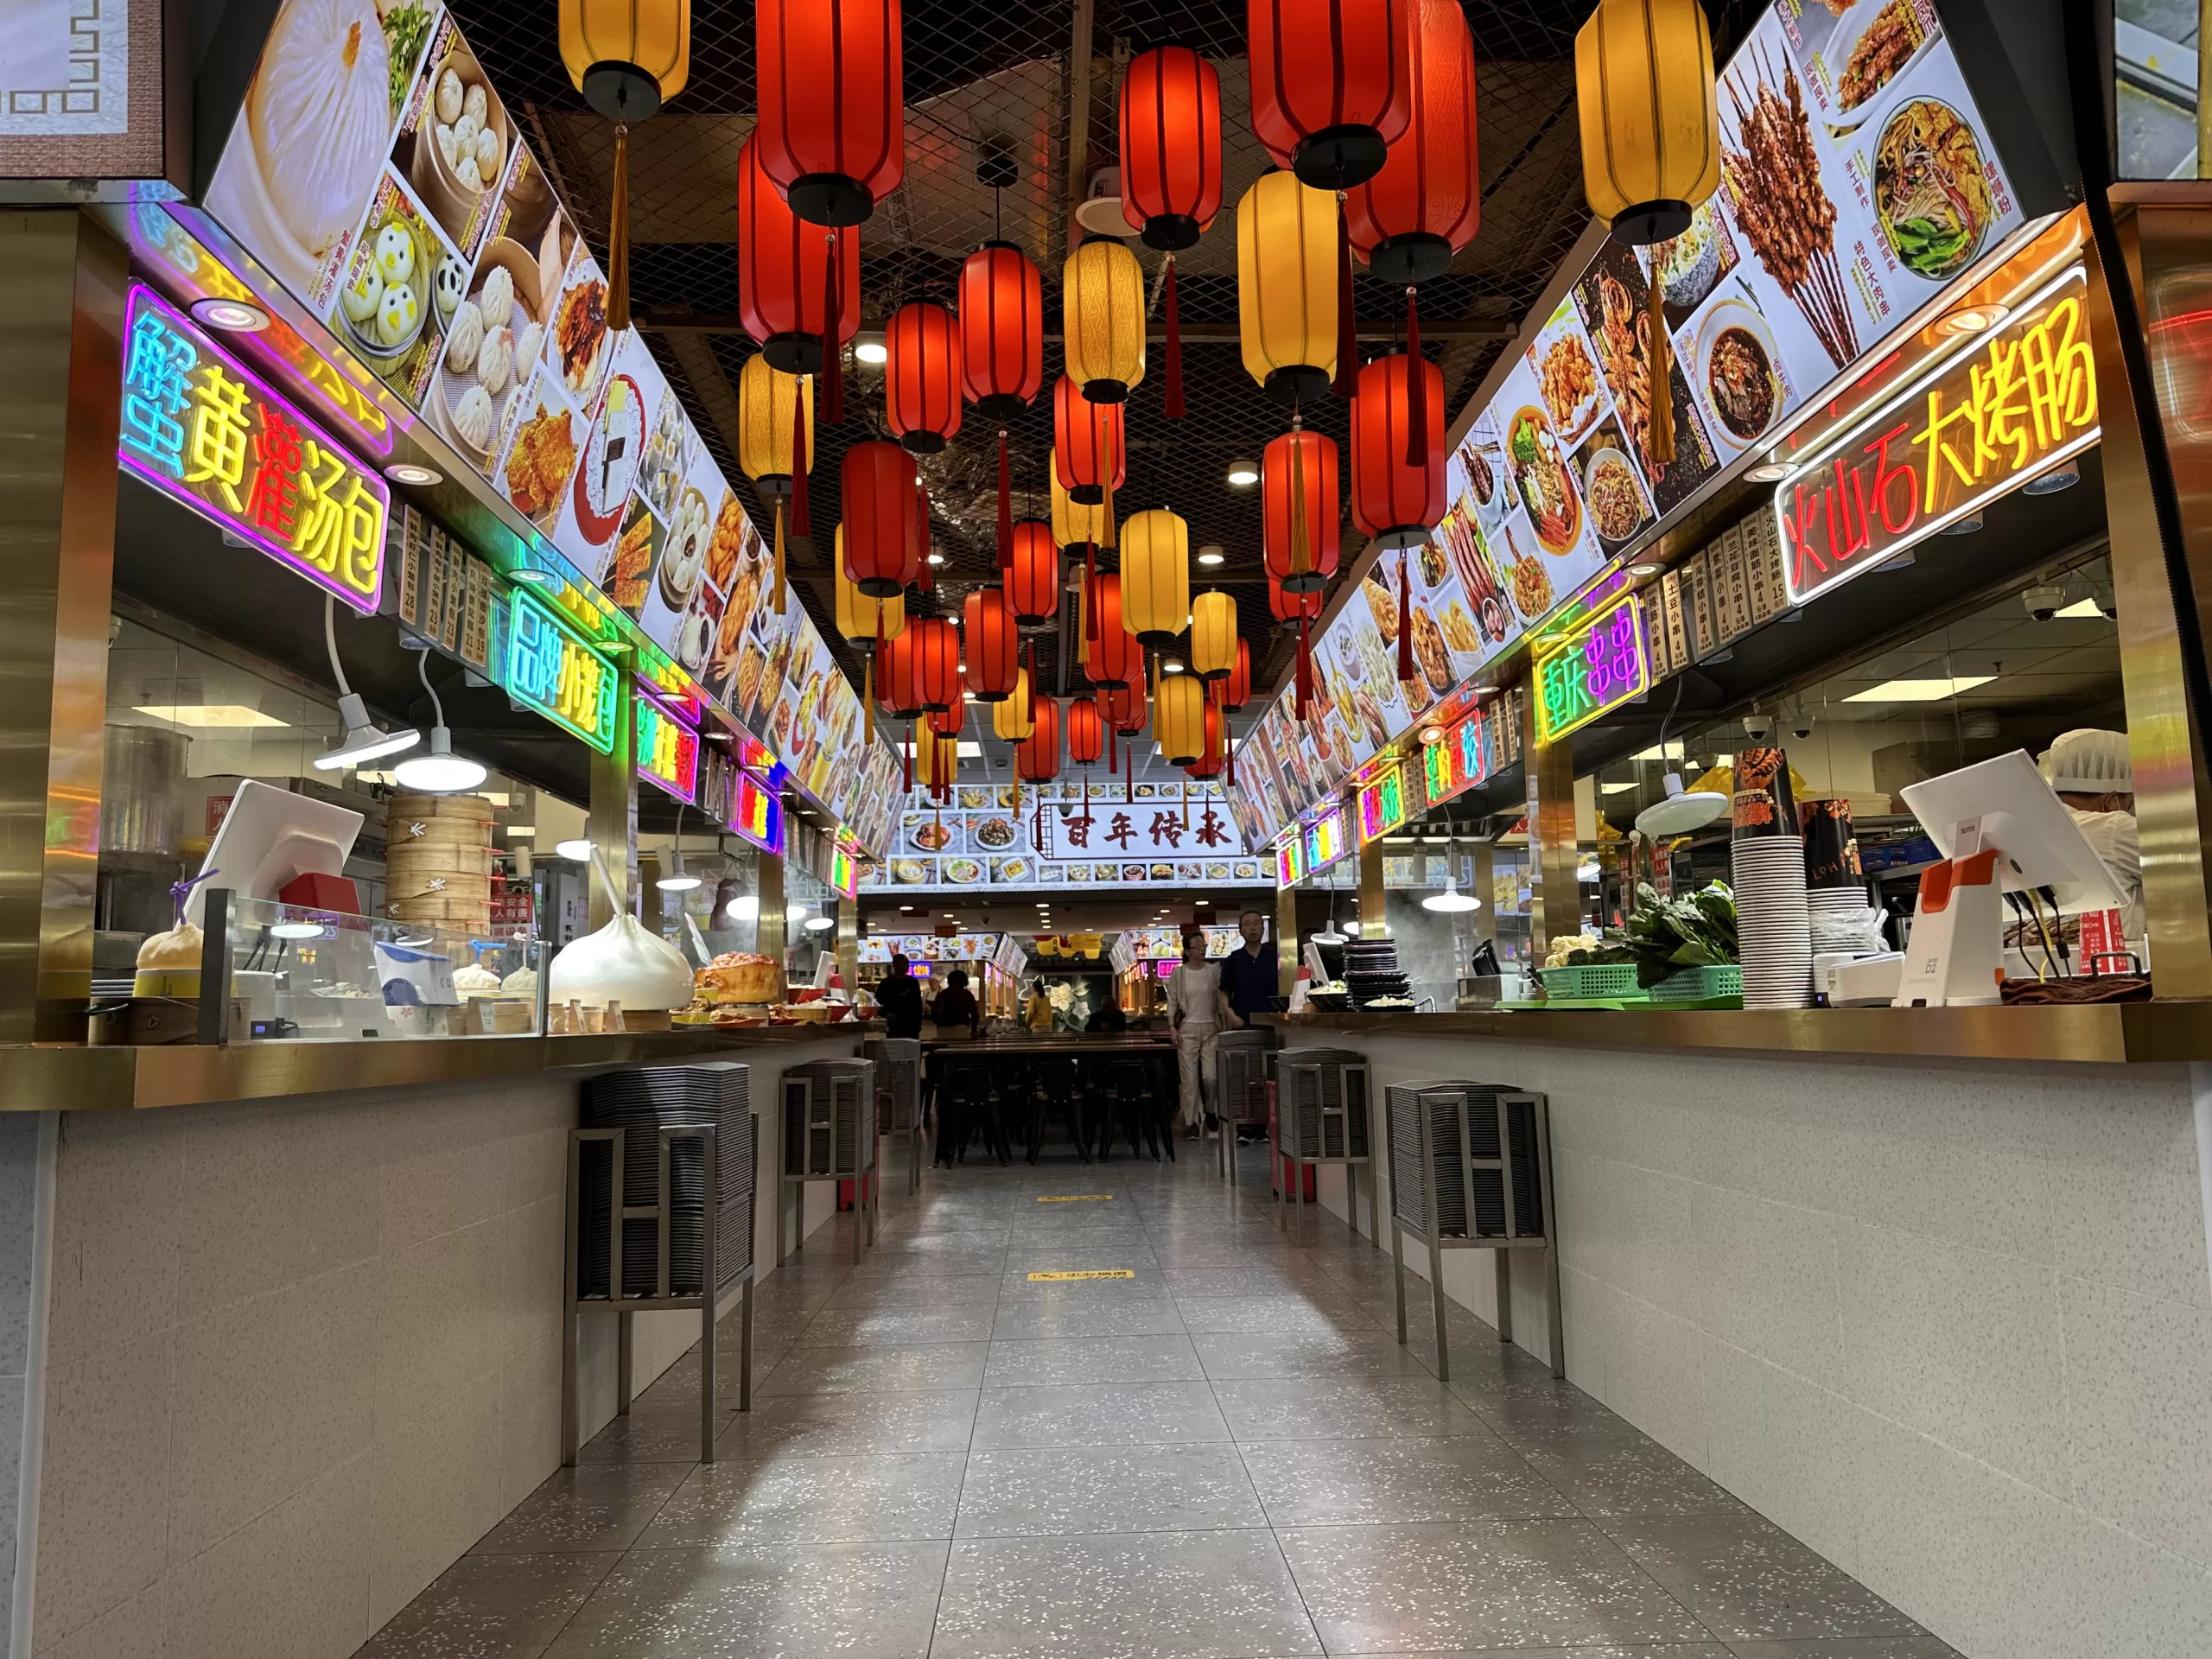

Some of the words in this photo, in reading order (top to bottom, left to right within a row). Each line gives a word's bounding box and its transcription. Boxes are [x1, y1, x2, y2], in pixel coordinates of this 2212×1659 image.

[1845, 159, 1871, 210] 手工制作
[1982, 160, 2012, 216] 螺蛳粉
[370, 179, 393, 229] 手工制作
[318, 229, 352, 309] 蟹黄灌汤包
[1853, 240, 1891, 316] 特色大肉串
[1772, 357, 1793, 399] 卤牛肉
[119, 311, 384, 594] 蟹黄灌汤包
[1783, 297, 2098, 588] 火山石大烤肠
[1746, 527, 1764, 592] 美味面筋小串
[1765, 515, 1781, 582] 火山石大烤肠
[1727, 541, 1743, 604] 兰花豆腐小串
[405, 593, 415, 609] 28
[1695, 564, 1707, 623] 海带结小串
[1757, 591, 1764, 603] 4
[1772, 583, 1784, 600] 15
[429, 609, 439, 625] 23
[1668, 583, 1681, 636] 土豆小串
[1721, 613, 1727, 625] 4
[1736, 603, 1742, 615] 4
[447, 621, 456, 636] 23
[465, 632, 474, 648] 21
[1701, 624, 1707, 636] 4
[476, 639, 486, 653] 19
[1656, 652, 1661, 663] 4
[1675, 640, 1681, 652] 4
[512, 604, 613, 743] 品牌小笼包
[1543, 607, 1638, 733] 重庆串串
[1061, 810, 1233, 850] 百年传承
[490, 897, 528, 907] 防安全
[491, 909, 528, 918] 人有责
[490, 926, 527, 937] 器设备
[1925, 963, 1937, 974] D2
